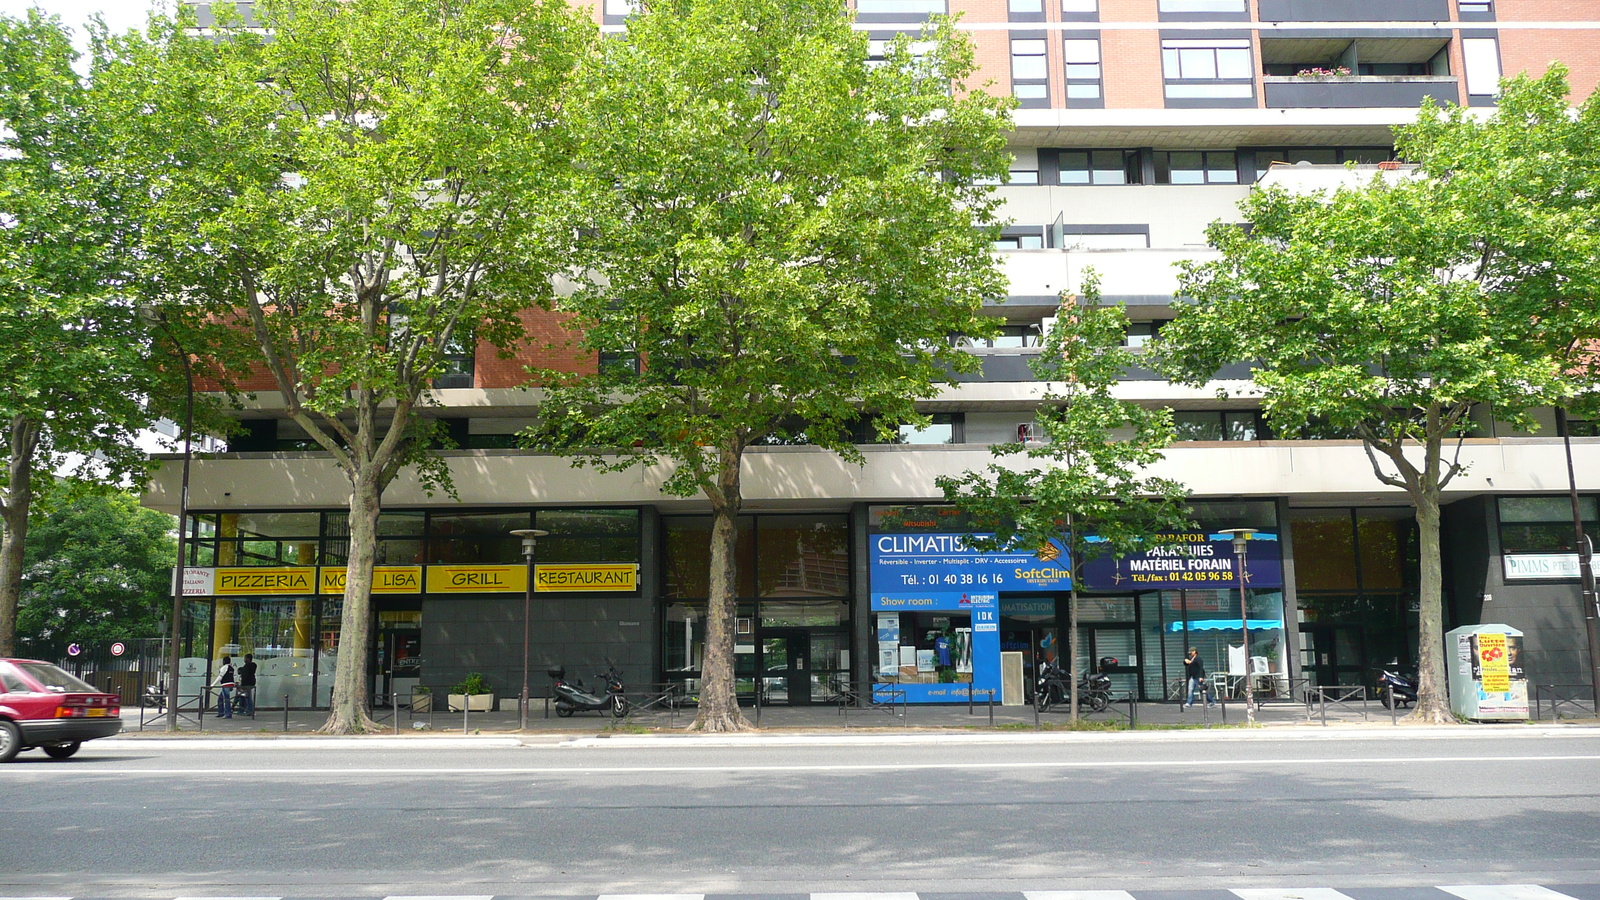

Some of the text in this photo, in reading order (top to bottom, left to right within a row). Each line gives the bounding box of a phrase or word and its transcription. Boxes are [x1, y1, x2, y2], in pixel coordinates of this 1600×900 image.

[1130, 558, 1231, 571] MATÉRIEL FORAIN
[1506, 556, 1549, 573] PIMMS
[452, 573, 503, 586] GRILL
[538, 571, 632, 584] RESTAURANT
[900, 574, 920, 585] Tél.
[928, 574, 939, 585] 01
[943, 574, 957, 585] 40
[960, 573, 973, 584] 38
[977, 573, 988, 584] 16
[992, 573, 1004, 584] 16
[1014, 568, 1071, 579] SoftClim
[1169, 572, 1180, 581] 01
[1182, 572, 1193, 581] 42
[1195, 572, 1206, 581] 05
[1208, 572, 1220, 581] 96
[1222, 572, 1233, 580] 58
[221, 575, 307, 587] PIZZERIA
[384, 574, 416, 586] LISA
[881, 597, 905, 606] Show
[908, 597, 932, 605] room
